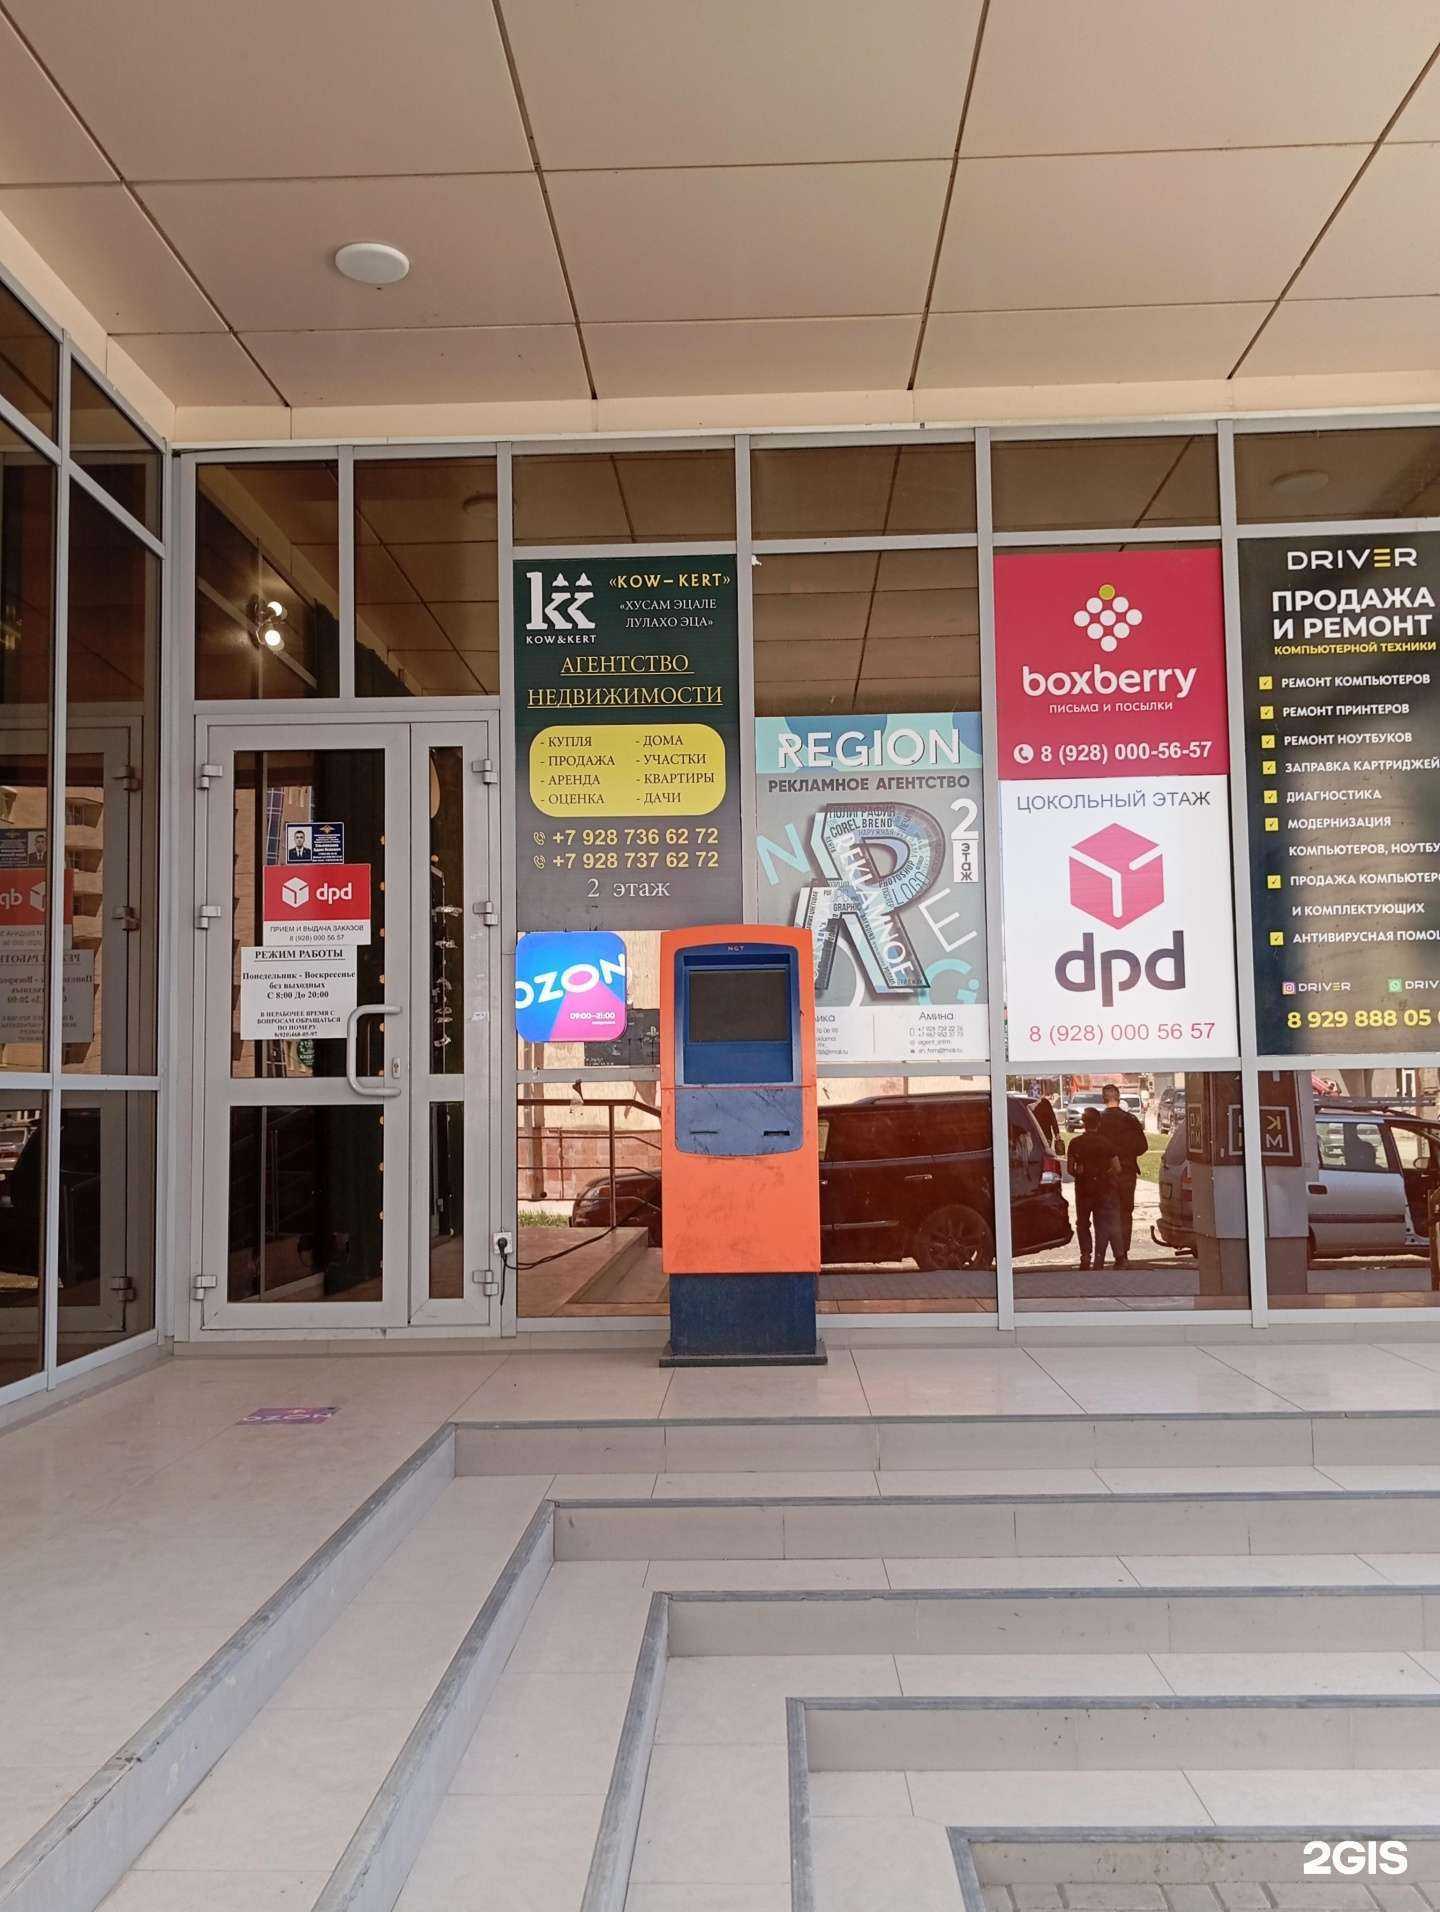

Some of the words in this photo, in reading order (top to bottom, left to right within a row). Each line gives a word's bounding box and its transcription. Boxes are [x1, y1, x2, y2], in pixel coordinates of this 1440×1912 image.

[1287, 547, 1418, 570] DRIVER
[673, 598, 717, 611] ЭЦАЛЕ
[1272, 587, 1435, 614] ПРОДАЖА
[625, 617, 677, 629] ЛУЛАХО
[1273, 619, 1294, 639] И
[1304, 614, 1432, 639] РЕМОНТ
[526, 634, 596, 645] KOW&KERT
[1274, 642, 1377, 655] КОМПЬЮТЕРНОЙ
[1380, 642, 1437, 653] ТЕХНИКИ
[561, 654, 688, 673] АГЕНТСТВО
[1022, 664, 1197, 698] boxberry
[1281, 677, 1332, 688] РЕМОНТ
[1335, 674, 1431, 687] КОМПЬЮТЕРОВ
[527, 686, 723, 708] НЕДВИЖИМОСТИ
[1050, 703, 1099, 714] письма
[1103, 703, 1111, 712] и
[1116, 701, 1173, 712] посылки
[1283, 706, 1333, 717] РЕМОНТ
[1336, 704, 1410, 716] ПРИНТЕРОВ
[548, 737, 592, 747] КУПЛЯ
[643, 735, 684, 746] ДОМА
[1284, 735, 1334, 746] РЕМОНТ
[1338, 732, 1412, 744] НОУТБУКОВ
[778, 728, 960, 768] REGION
[1041, 746, 1053, 762] 8
[1059, 744, 1108, 765] (928)
[1115, 741, 1212, 760] 000-56-57
[548, 756, 615, 767] ПРОДАЖА
[644, 754, 706, 765] УЧАСТКИ
[1285, 762, 1351, 773] ЗАПРАВКА
[1354, 756, 1440, 772] КАРТРИДЖЕЙ
[548, 775, 600, 786] АРЕНДА
[644, 773, 715, 784] КВАРТИРЫ
[768, 778, 869, 792] РЕКЛАМНОЕ
[876, 775, 970, 790] АГЕНТСТВО
[548, 793, 605, 804] ОЦЕНКА
[644, 792, 681, 804] ДАЧИ
[1016, 790, 1146, 814] ЦОКОЛЬНЫЙ
[1152, 791, 1211, 807] ЭТАЖ
[1286, 789, 1382, 803] ДИАГНОСТИКА
[951, 798, 979, 841] 2
[1288, 816, 1391, 829] МОДЕРНИЗАЦИЯ
[830, 818, 860, 838] COREL
[553, 830, 576, 845] +7
[583, 830, 618, 845] 928
[624, 829, 659, 845] 736
[665, 829, 689, 844] 62
[696, 828, 719, 844] 72
[1289, 844, 1389, 856] КОМПЬЮТЕРОВ,
[553, 854, 576, 869] +7
[583, 853, 618, 869] 928
[625, 853, 659, 868] 737
[666, 852, 689, 867] 62
[696, 852, 719, 868] 72
[1290, 875, 1356, 886] ПРОДАЖА
[1359, 872, 1440, 884] КОМПЬЮТЕР
[316, 883, 352, 904] dpd
[587, 879, 600, 897] 2
[613, 882, 670, 897] этаж
[1292, 906, 1301, 916] И
[1305, 903, 1425, 916] КОМПЛЕКТУЮЩИХ
[1293, 932, 1393, 943] АНТИВИРУСНАЯ
[1397, 930, 1440, 941] ПОМО
[255, 950, 296, 959] РЕЖИМ
[300, 949, 343, 958] РАБОТЫ
[1055, 930, 1186, 1007] dpd
[243, 973, 297, 981] Понедельник
[305, 971, 356, 980] Воскресенье
[1298, 981, 1351, 991] DRIVER
[1405, 979, 1440, 989] DRIV
[308, 991, 329, 999] 20:00
[1288, 1012, 1302, 1028] 8
[1308, 1011, 1348, 1028] 929
[1355, 1010, 1398, 1027] 888
[1404, 1009, 1432, 1026] 05
[1029, 1026, 1042, 1042] 8
[1050, 1025, 1104, 1046] (928)
[1111, 1024, 1150, 1040] 000
[1157, 1023, 1183, 1040] 56
[1190, 1022, 1216, 1039] 57
